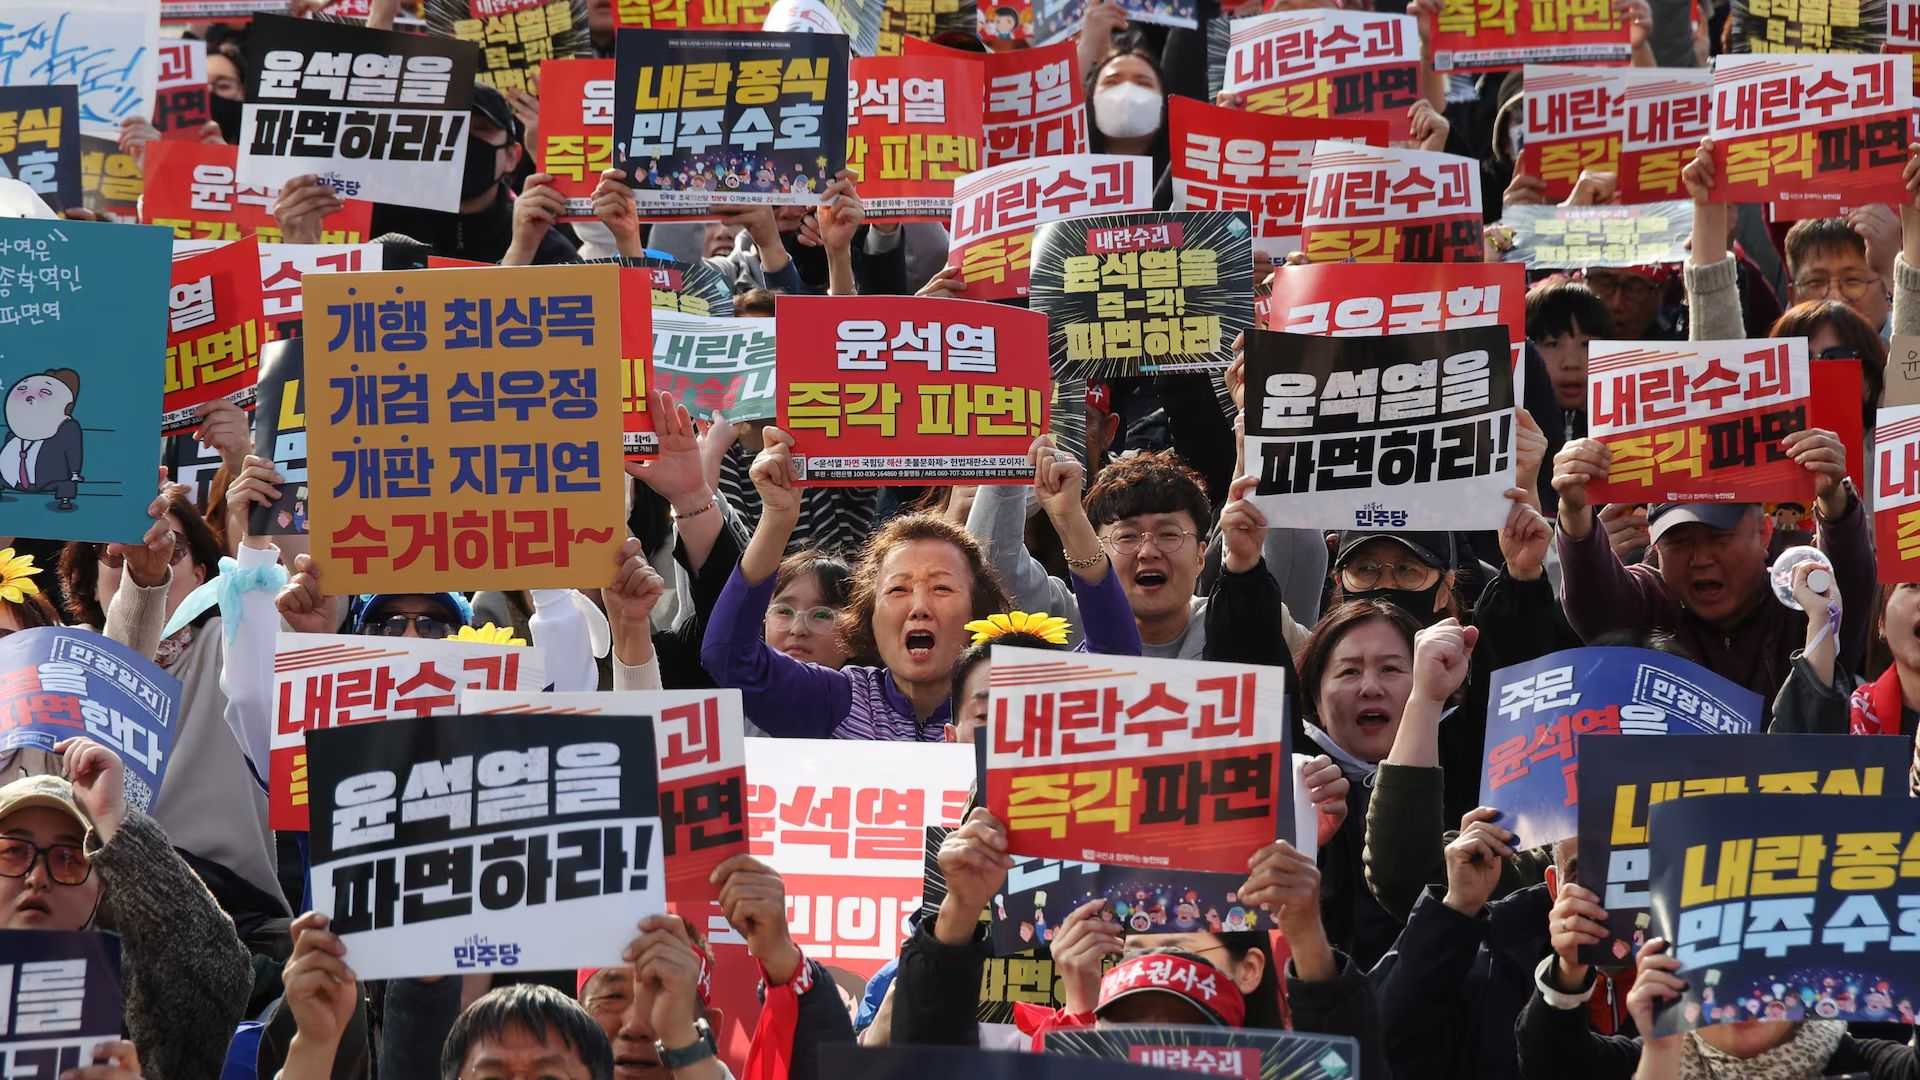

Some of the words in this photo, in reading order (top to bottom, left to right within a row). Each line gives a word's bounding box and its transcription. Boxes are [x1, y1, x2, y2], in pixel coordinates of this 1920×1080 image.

[257, 49, 453, 105] 윤석열을
[1233, 19, 1404, 84] 내란수괴
[634, 62, 734, 111] 내란
[735, 57, 830, 105] 종식
[988, 59, 1072, 116] 국힘
[1528, 86, 1624, 135] 내란
[1717, 60, 1895, 132] 내란수괴
[249, 108, 465, 163] 파면하라!
[630, 109, 725, 158] 민주
[728, 103, 824, 152] 수호
[983, 107, 1086, 168] 한다!
[0, 150, 59, 195] 호
[955, 161, 1135, 239] 내란수괴
[1306, 162, 1472, 219] 내란수괴
[1095, 223, 1170, 250] 내란수괴
[1063, 249, 1219, 294] 윤석열을
[327, 298, 428, 353] 개행
[443, 295, 595, 350] 최상목
[836, 319, 997, 373] 윤석열
[1064, 316, 1222, 361] 파면하라
[164, 318, 258, 393] 파면!
[329, 373, 430, 427] 개검
[447, 368, 598, 425] 심우정
[787, 382, 902, 437] 즉각
[917, 383, 1042, 438] 파면!
[1261, 350, 1490, 429] 윤석열을
[1593, 343, 1791, 427] 내란수괴
[331, 445, 435, 499] 개판
[449, 440, 601, 496] 지귀연
[844, 458, 860, 468] 파면
[1255, 413, 1512, 496] 파면하라!
[330, 507, 614, 575] 수거하라~
[1355, 510, 1408, 527] 민주당
[994, 672, 1256, 759] 내란수괴
[1498, 665, 1580, 721] 주문,
[332, 742, 621, 851] 윤석열을
[330, 825, 655, 935] 파면하라!
[1680, 834, 1826, 908] 내란
[454, 943, 521, 968] 민주당
[1677, 897, 1815, 972] 민주
